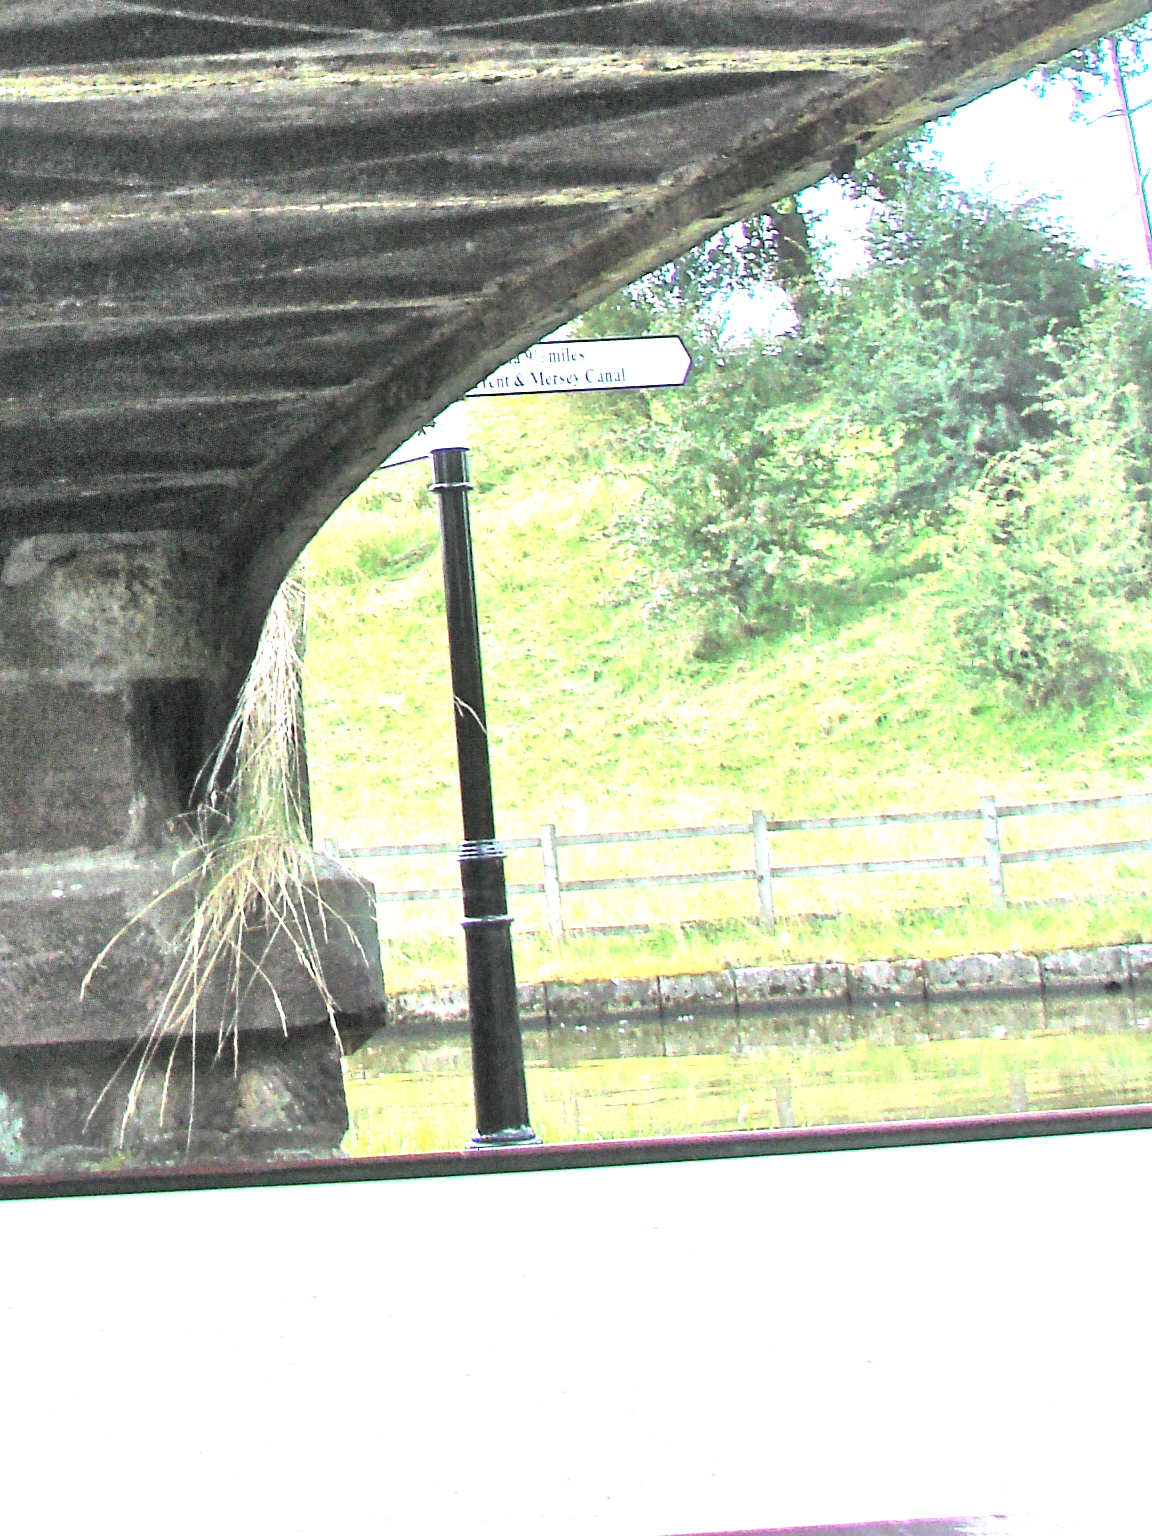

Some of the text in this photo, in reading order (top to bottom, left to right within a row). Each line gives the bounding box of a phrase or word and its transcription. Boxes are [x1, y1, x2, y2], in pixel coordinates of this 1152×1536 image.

[549, 348, 585, 363] miles
[477, 367, 627, 389] rent & Mersey Canal
